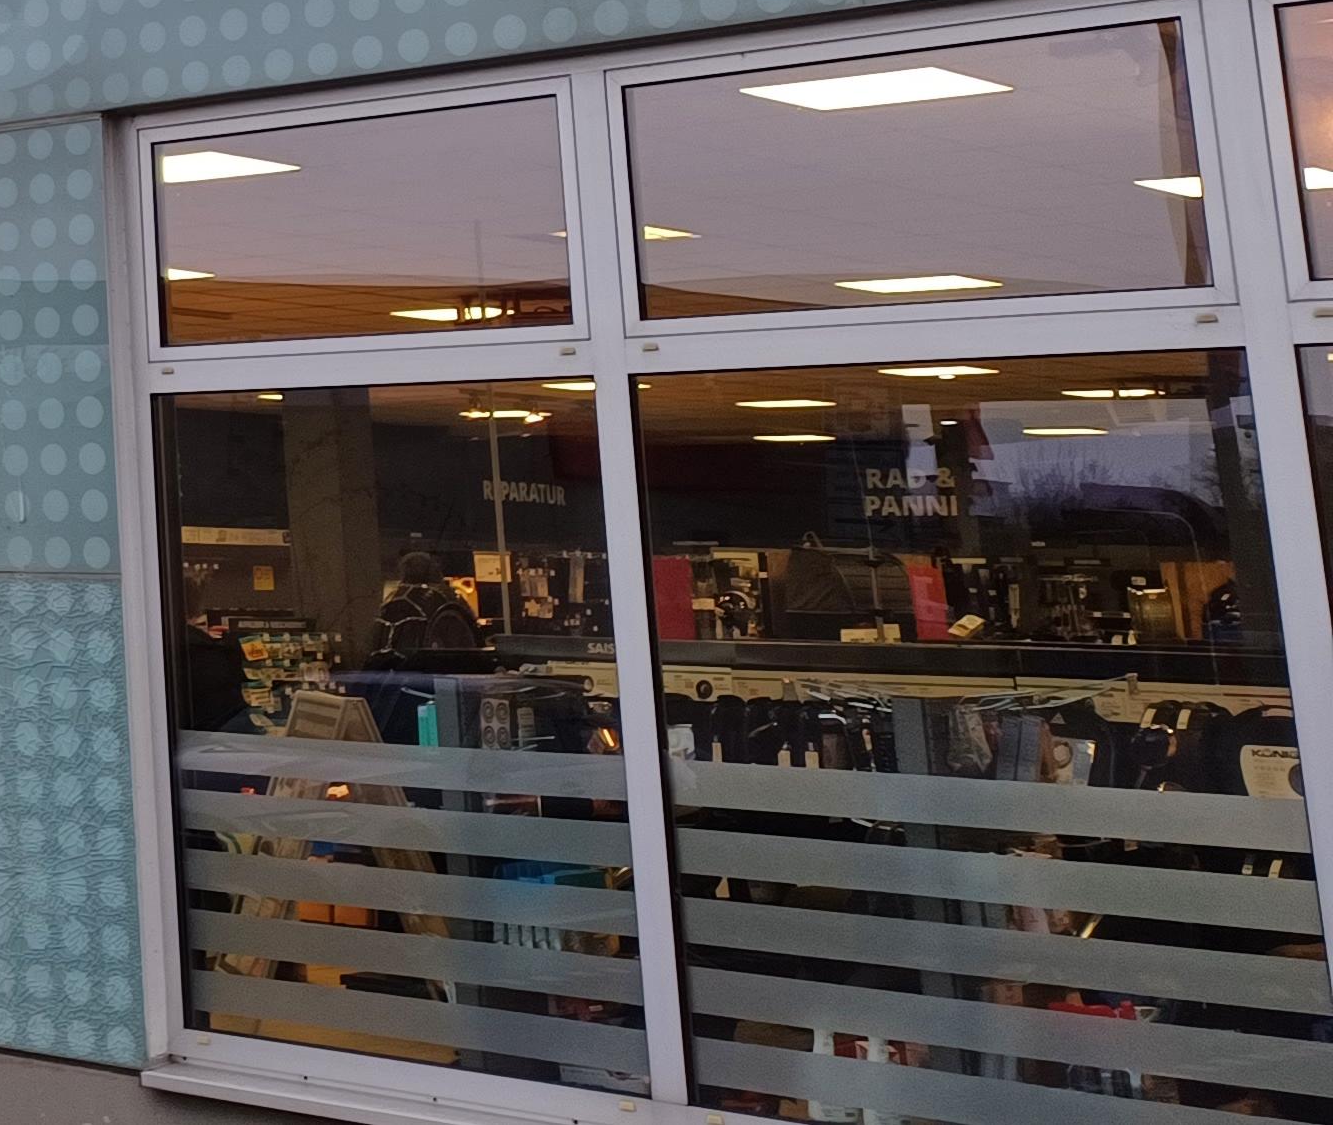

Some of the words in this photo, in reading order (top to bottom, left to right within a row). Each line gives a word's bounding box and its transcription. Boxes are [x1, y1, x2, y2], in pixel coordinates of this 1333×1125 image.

[865, 467, 927, 489] RAD
[936, 467, 955, 488] &
[483, 480, 566, 506] RPARATUR
[865, 495, 958, 516] PANNI
